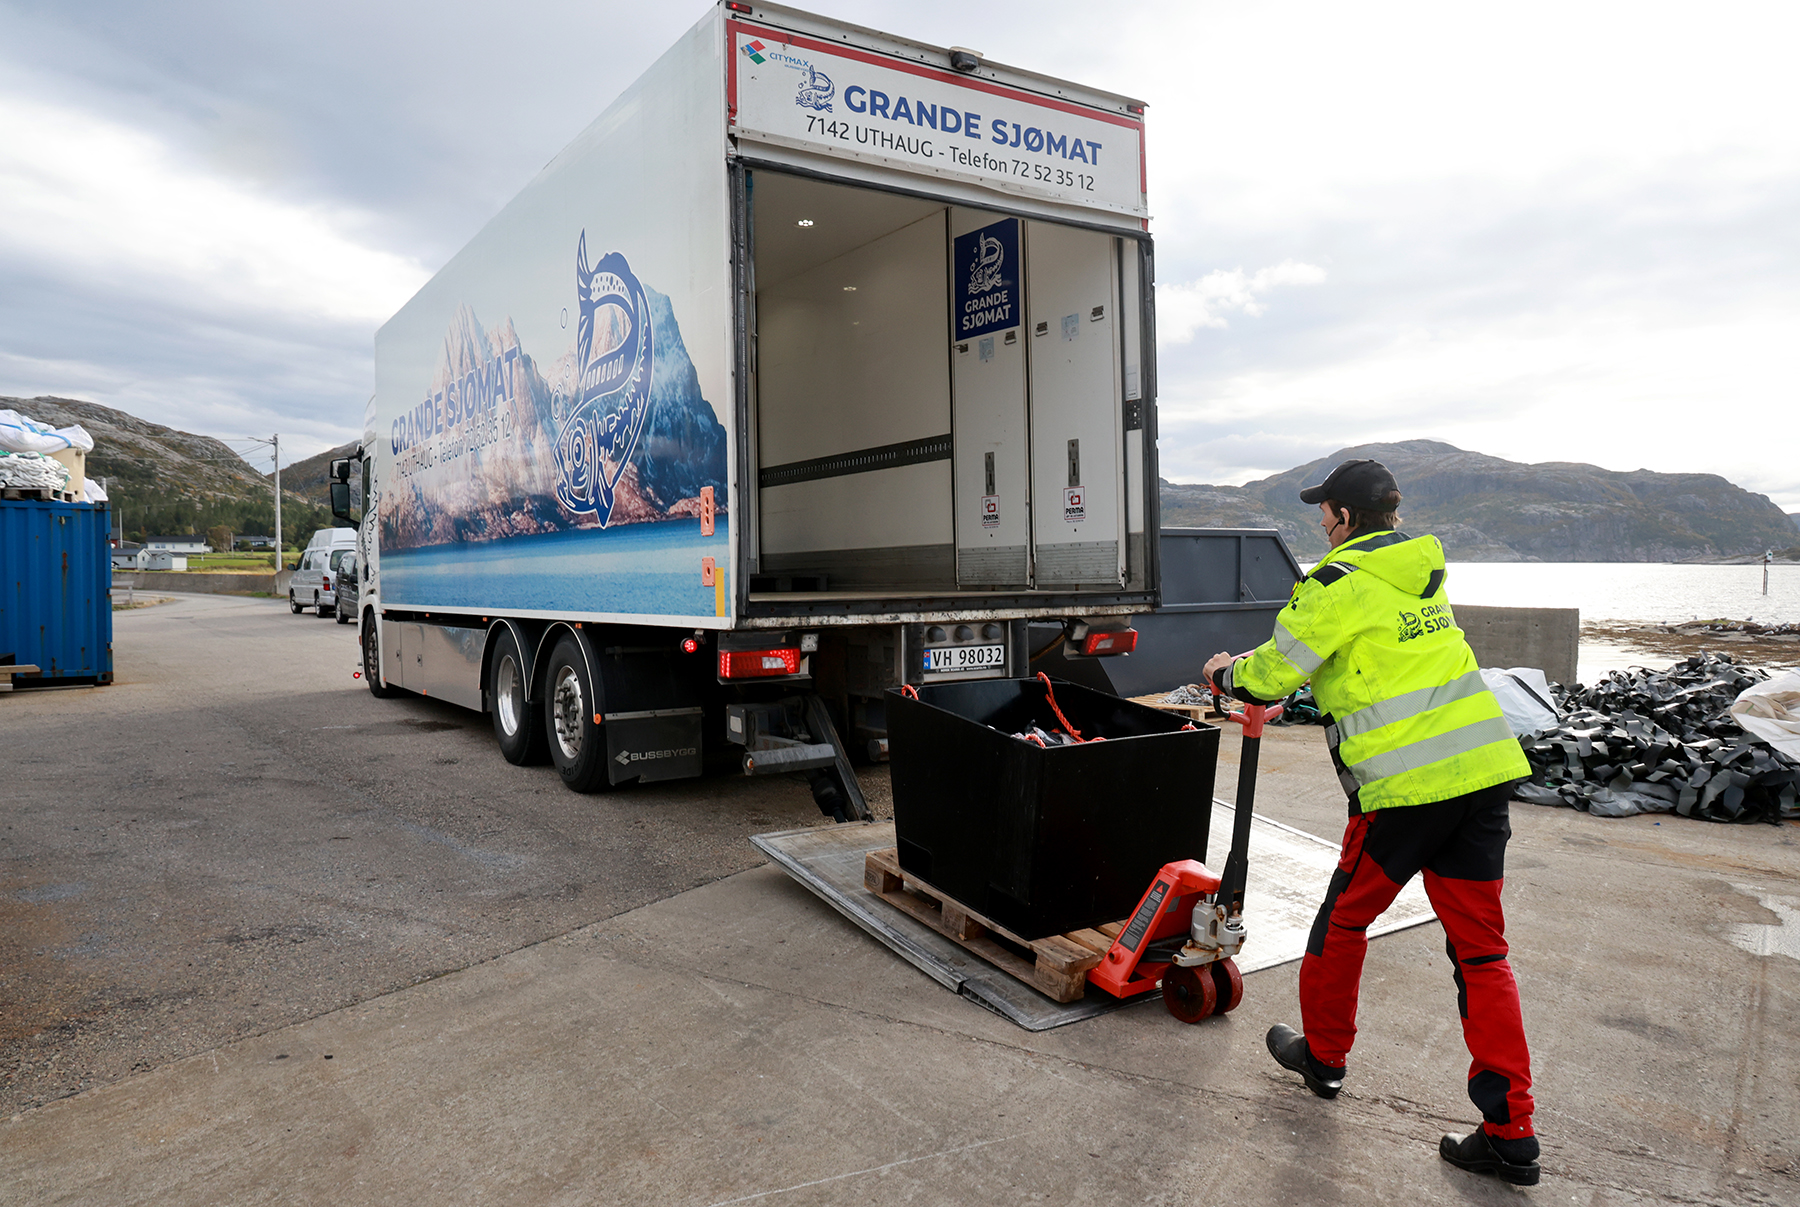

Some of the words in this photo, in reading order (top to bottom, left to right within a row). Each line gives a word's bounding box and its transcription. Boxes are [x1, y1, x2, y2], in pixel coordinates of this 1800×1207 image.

[769, 52, 809, 67] CITYMAX
[844, 85, 981, 140] GRANDE
[991, 119, 1102, 166] SJØMAT
[806, 115, 849, 140] 7142
[855, 125, 933, 158] UTHAUG
[949, 145, 1007, 173] Telefon
[1011, 159, 1029, 178] 72
[1034, 164, 1051, 182] 52
[1056, 169, 1074, 187] 35
[1078, 173, 1095, 191] 12
[965, 290, 1008, 313] GRANDE
[962, 304, 1011, 330] SJØMAT
[391, 391, 443, 456] GRANDE
[447, 345, 518, 428] SJØMAT
[501, 410, 511, 439] 12
[932, 650, 952, 666] VH
[959, 647, 1002, 665] 98032
[630, 747, 697, 761] BUSSBYGG
